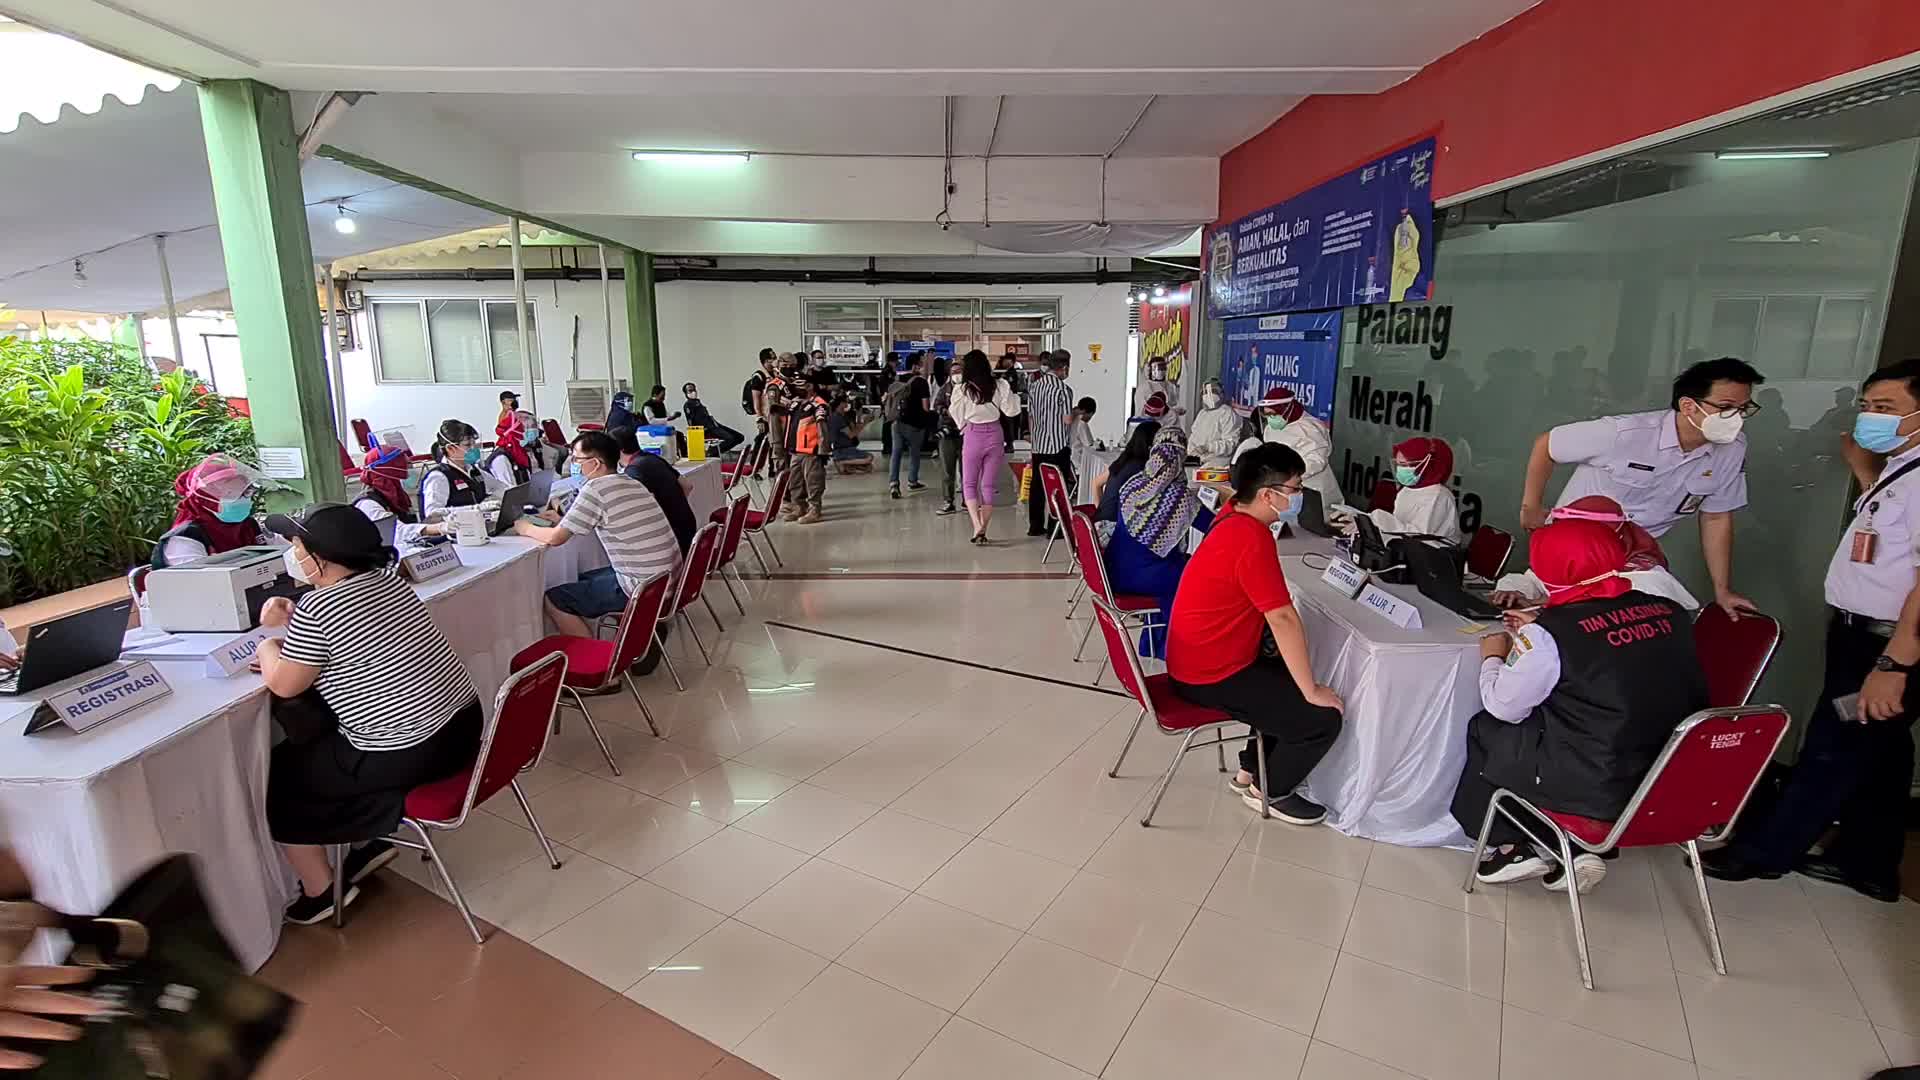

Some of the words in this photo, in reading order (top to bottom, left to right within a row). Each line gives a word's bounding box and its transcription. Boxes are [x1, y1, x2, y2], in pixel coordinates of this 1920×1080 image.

[1237, 231, 1261, 253] AMAN,
[1262, 222, 1291, 246] HALAL,
[1292, 216, 1309, 237] dan
[1236, 245, 1287, 274] BERKUALITAS
[1356, 304, 1453, 360] Palang
[1264, 354, 1299, 378] RUANG
[1349, 376, 1433, 433] Merah
[1341, 448, 1483, 534] India
[415, 552, 455, 572] REGISTRASI
[1328, 566, 1358, 589] REGISTRASI
[1366, 593, 1388, 610] ALUR
[1388, 604, 1396, 615] 1
[1578, 615, 1609, 633] TIM
[1607, 619, 1673, 647] COVID-19
[229, 640, 257, 663] ALUR
[66, 673, 160, 718] REGISTRASI
[1710, 739, 1741, 749] TENDA
[1711, 732, 1746, 741] LUCKY
